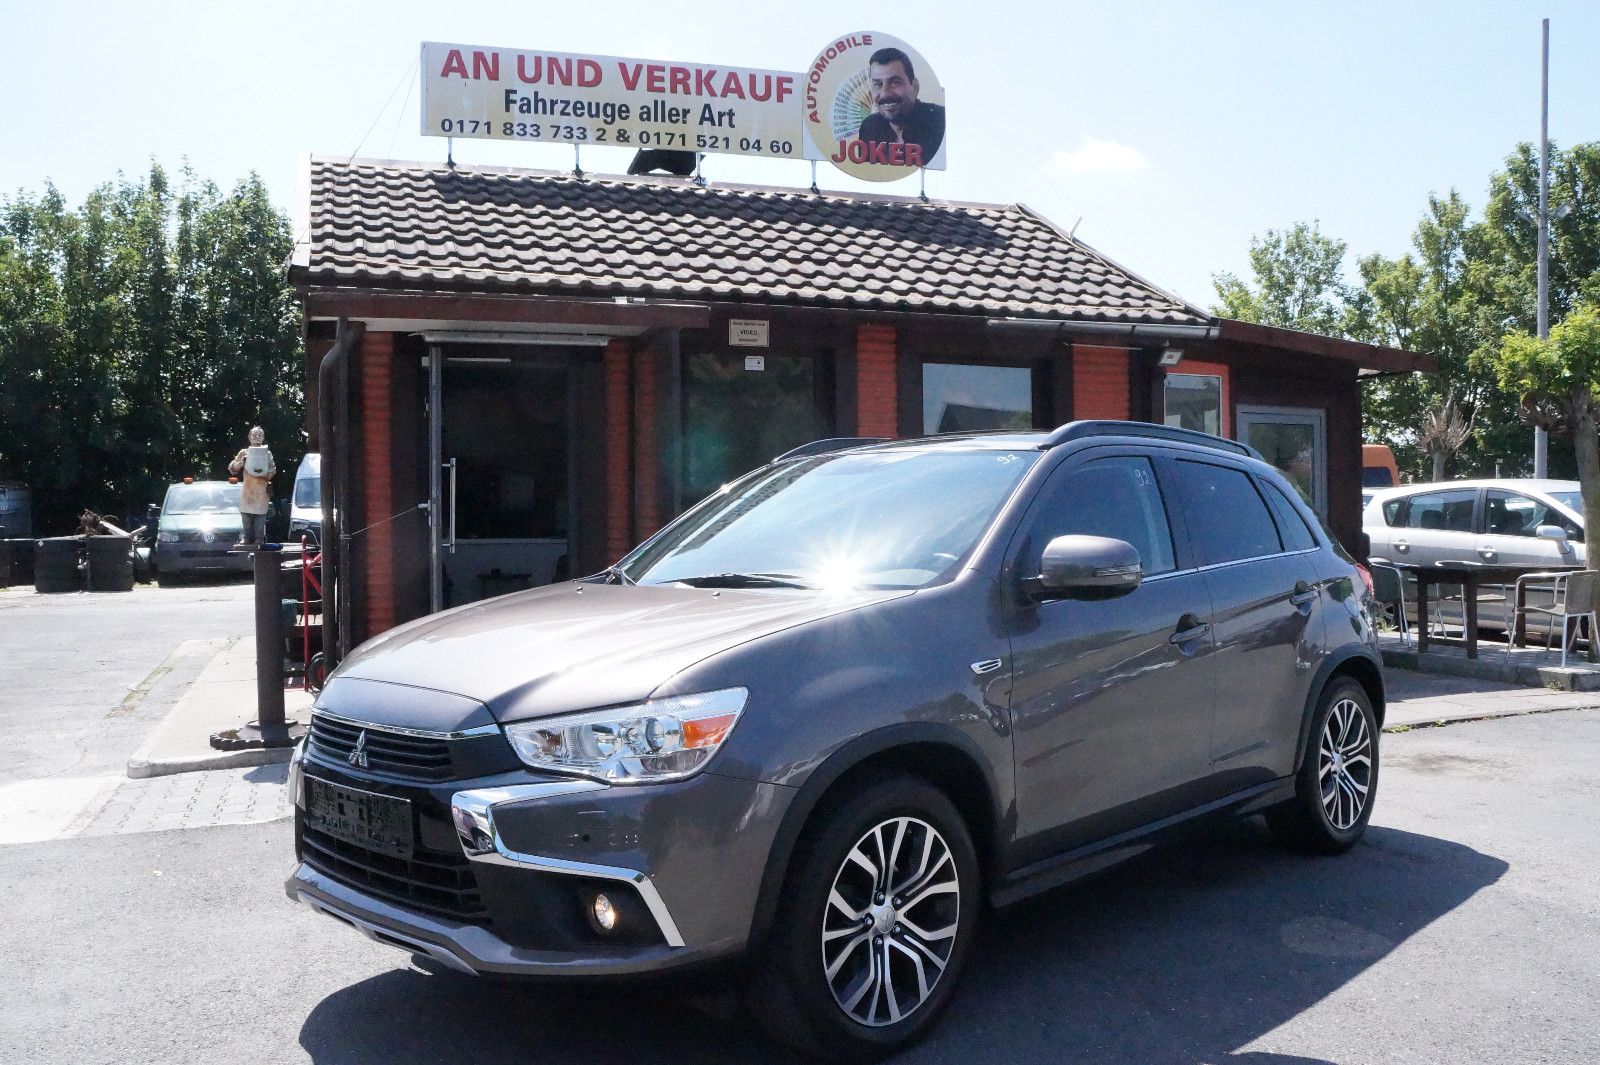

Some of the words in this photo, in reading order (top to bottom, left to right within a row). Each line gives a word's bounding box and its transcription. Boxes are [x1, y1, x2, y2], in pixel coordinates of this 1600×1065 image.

[440, 49, 500, 81] AN
[517, 54, 602, 87] UND
[618, 62, 793, 103] VERKAUF
[807, 35, 872, 123] AUTOMOBILE
[504, 89, 631, 125] Fahrzeuge
[639, 100, 691, 124] aller
[699, 103, 736, 128] Art
[440, 118, 492, 135] 0171
[502, 122, 541, 138] 833
[550, 125, 587, 140] 733
[595, 127, 607, 142] 2
[616, 128, 631, 143] &
[639, 131, 686, 147] 0171
[696, 134, 731, 149] 521
[739, 137, 763, 151] 04
[769, 141, 793, 154] 60
[831, 138, 924, 167] JOKER
